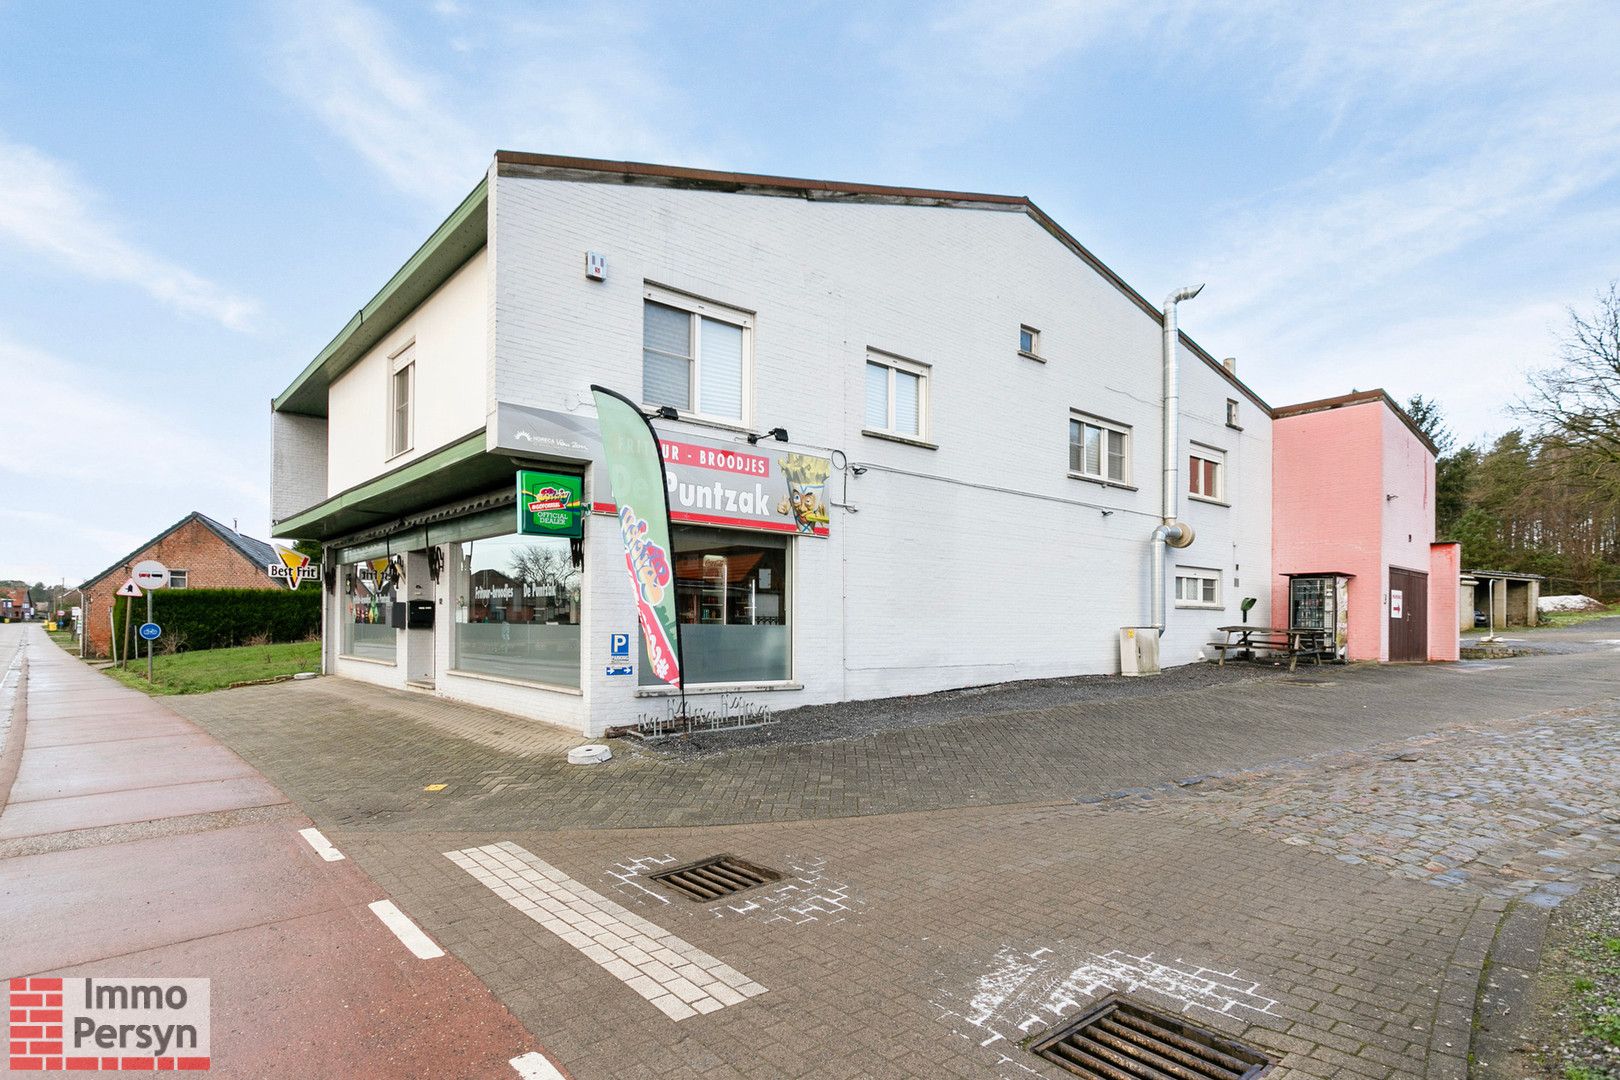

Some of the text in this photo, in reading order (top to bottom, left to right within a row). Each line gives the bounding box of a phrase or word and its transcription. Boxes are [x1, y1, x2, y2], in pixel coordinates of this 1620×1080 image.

[699, 449, 765, 474] BROODJES
[665, 471, 770, 516] Puntzak
[537, 511, 569, 520] OFFICIAL
[540, 517, 566, 525] DEALER
[271, 565, 316, 578] Best Frit
[614, 635, 627, 653] P
